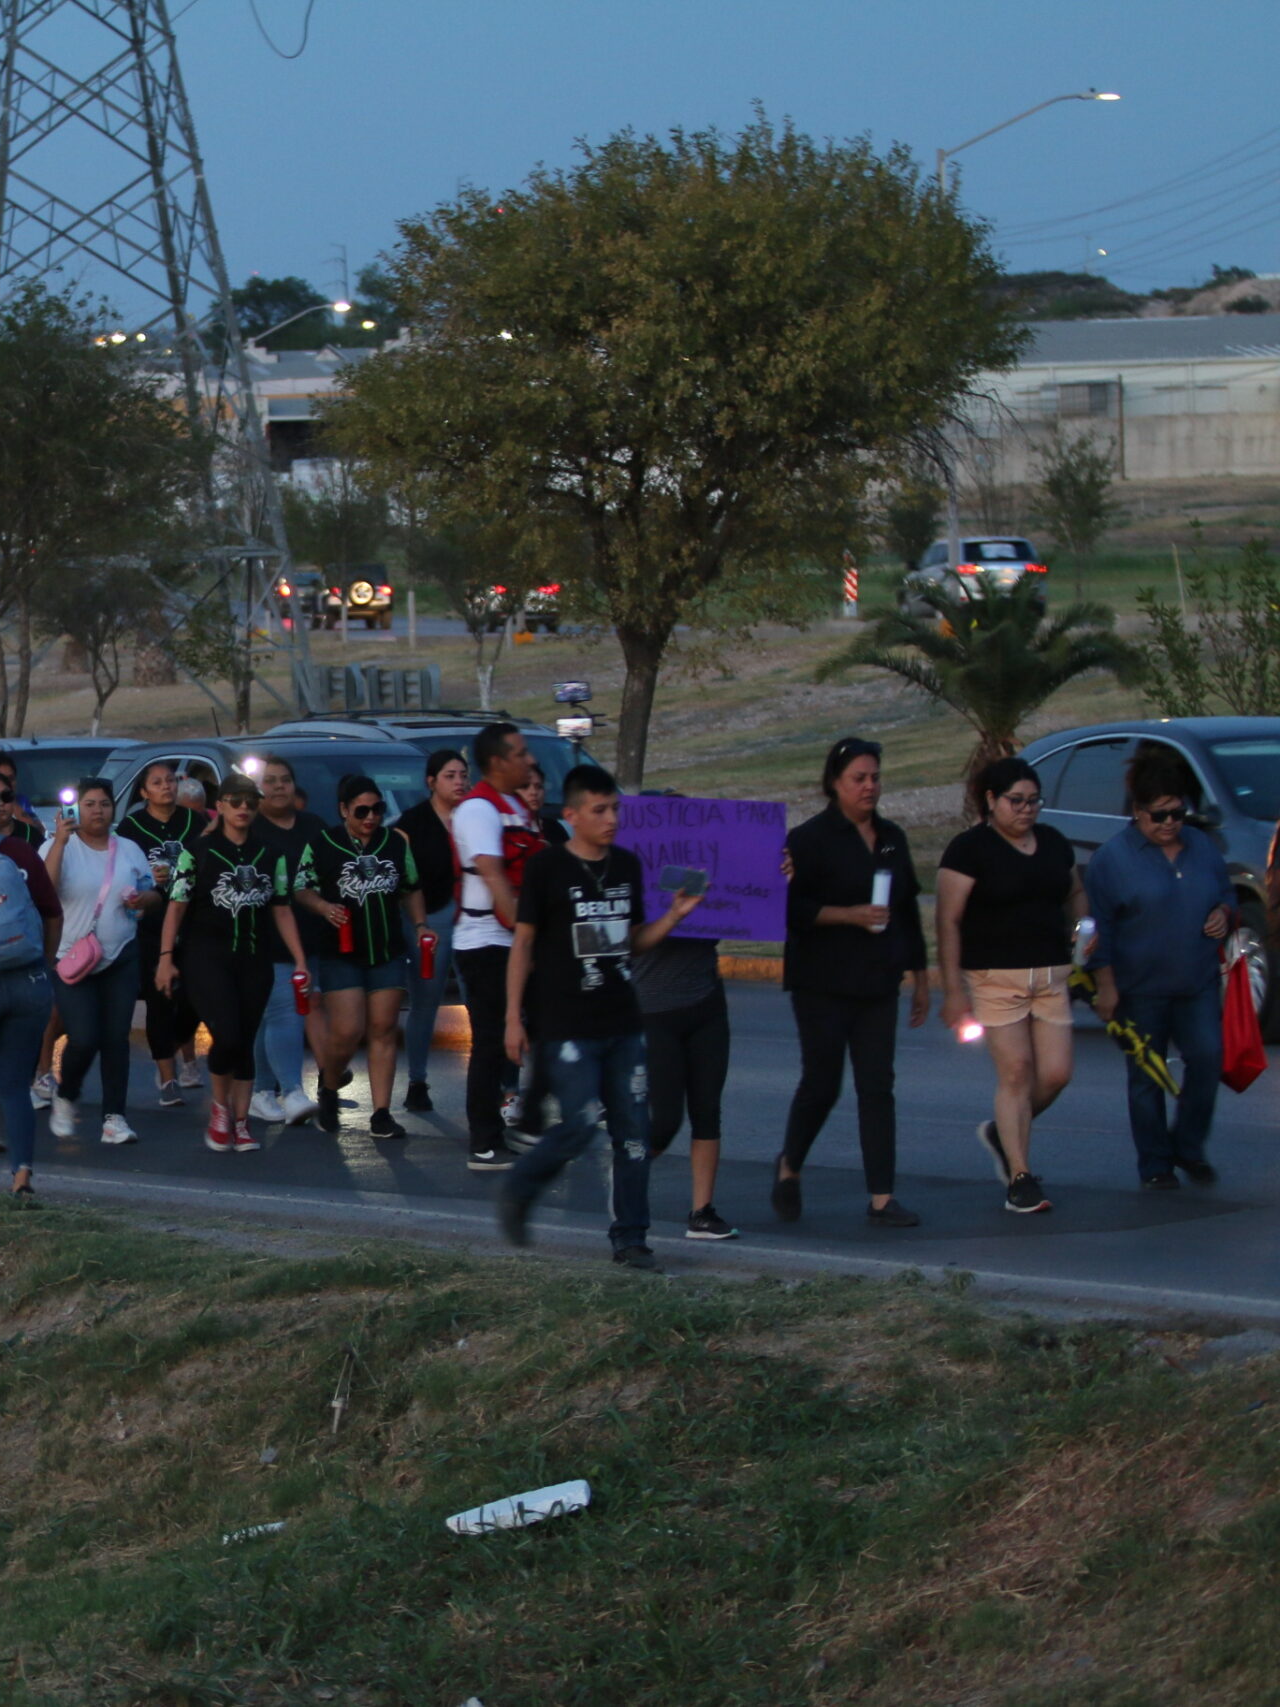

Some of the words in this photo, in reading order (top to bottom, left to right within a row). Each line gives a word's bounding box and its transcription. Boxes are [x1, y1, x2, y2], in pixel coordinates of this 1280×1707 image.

[618, 802, 725, 830] JUSTICIA
[737, 802, 787, 827] PARA
[576, 899, 631, 918] BERLIN
